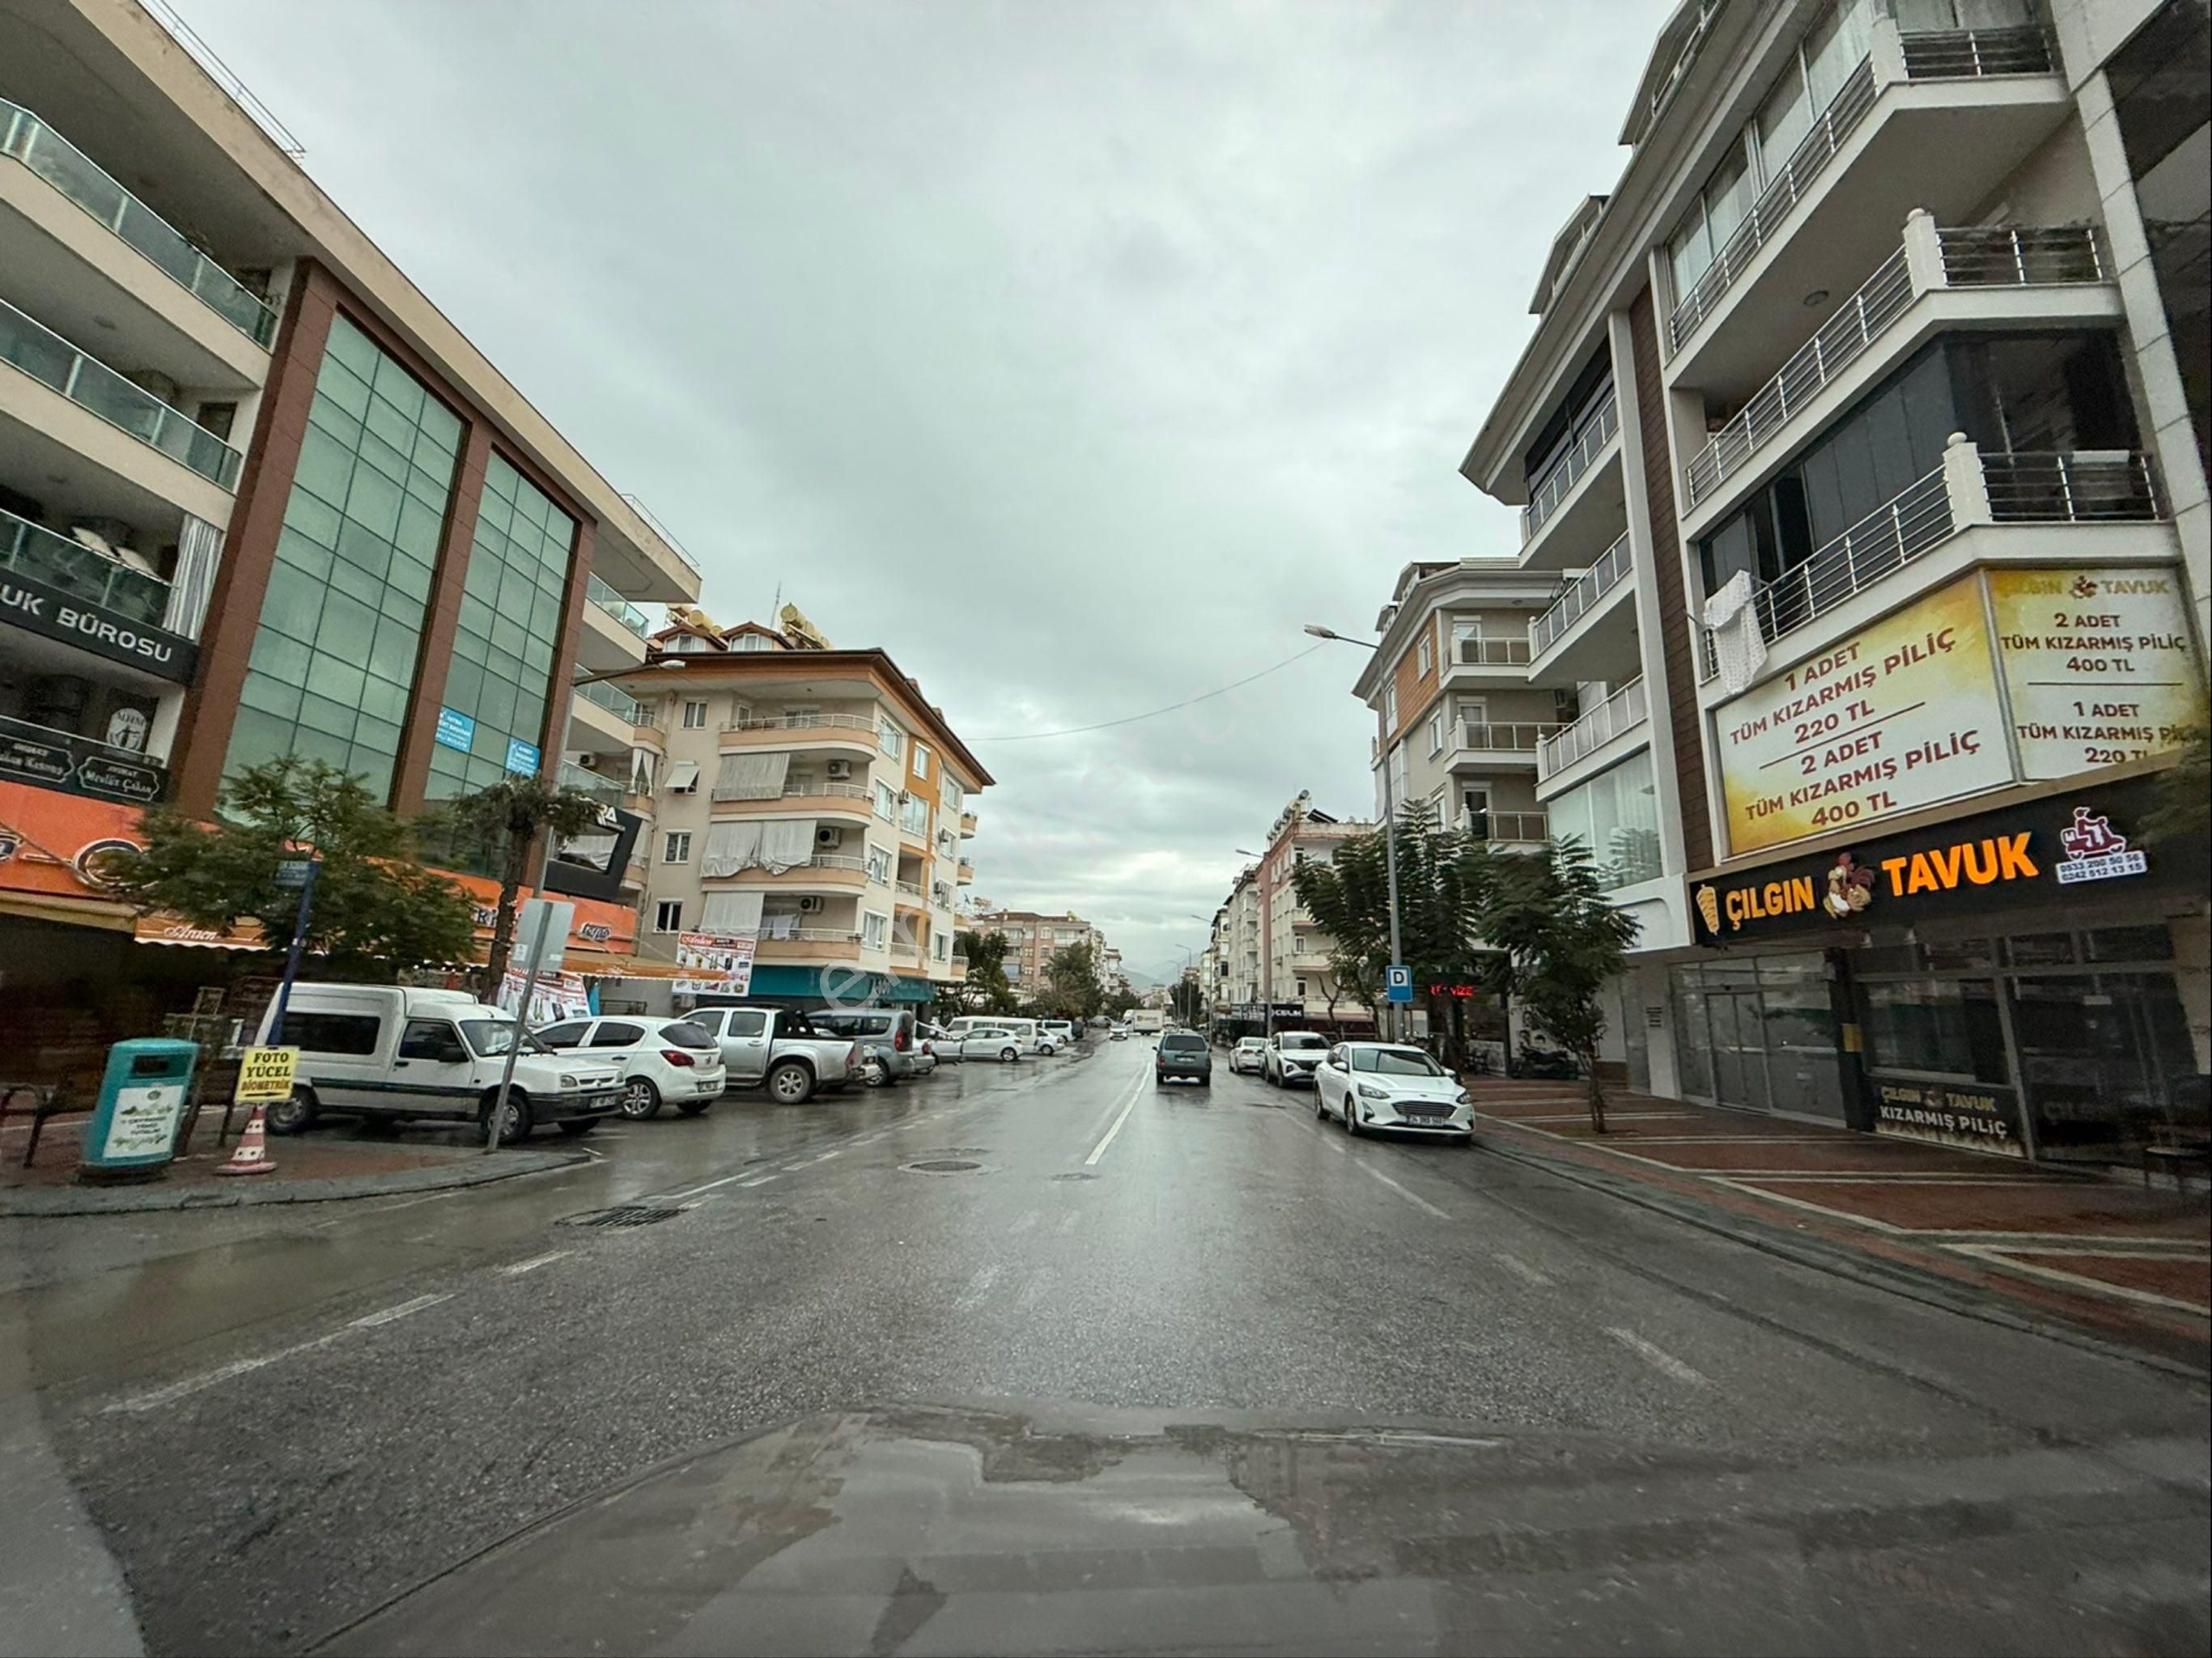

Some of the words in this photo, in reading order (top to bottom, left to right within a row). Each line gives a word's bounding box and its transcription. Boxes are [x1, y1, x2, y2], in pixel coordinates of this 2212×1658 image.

[2100, 579, 2168, 595] TAVUK
[0, 583, 45, 616] UK
[56, 606, 172, 664] BÜROSU
[2053, 613, 2069, 627] 2
[2074, 614, 2121, 627] ADET
[2000, 634, 2040, 649] TÜM
[2045, 636, 2133, 652] KIZARMIŞ
[2138, 633, 2188, 653] PİLİÇ
[1785, 675, 1797, 692] 1
[1803, 641, 1862, 685] ADET
[2066, 656, 2107, 672] 400
[2112, 659, 2135, 672] TL
[1730, 715, 1768, 745] TÜM
[1772, 667, 1877, 726] KIZARMIŞ
[1883, 626, 1958, 675] PİLİÇ
[2074, 701, 2084, 716] 1
[2091, 703, 2139, 717] ADET
[1794, 712, 1839, 744] 220
[1845, 699, 1875, 721] TL
[2016, 723, 2057, 739] TÜM
[2063, 727, 2153, 743] KIZARMIŞ
[1800, 757, 1816, 775] 2
[1824, 731, 1883, 768] ADET
[2084, 747, 2125, 763] 220
[1745, 793, 1785, 821] TÜM
[1789, 756, 1899, 807] KIZARMIŞ
[1904, 729, 1981, 770] PİLİÇ
[1811, 802, 1860, 829] 400
[1866, 791, 1897, 812] TL
[2089, 868, 2108, 877] 512
[2111, 866, 2125, 874] 13
[2128, 863, 2142, 871] 15
[1726, 875, 1815, 931] ÇILGIN
[1882, 831, 2040, 898] TAVUK
[1393, 971, 1404, 984] D
[253, 1052, 290, 1063] FOTO
[246, 1064, 291, 1078] YÜCEL
[1881, 1086, 1921, 1103] ÇILGIN
[1945, 1092, 1997, 1112] TAVUK
[1879, 1105, 1955, 1132] KIZARMIŞ
[1958, 1115, 2008, 1140] PİLİÇ
